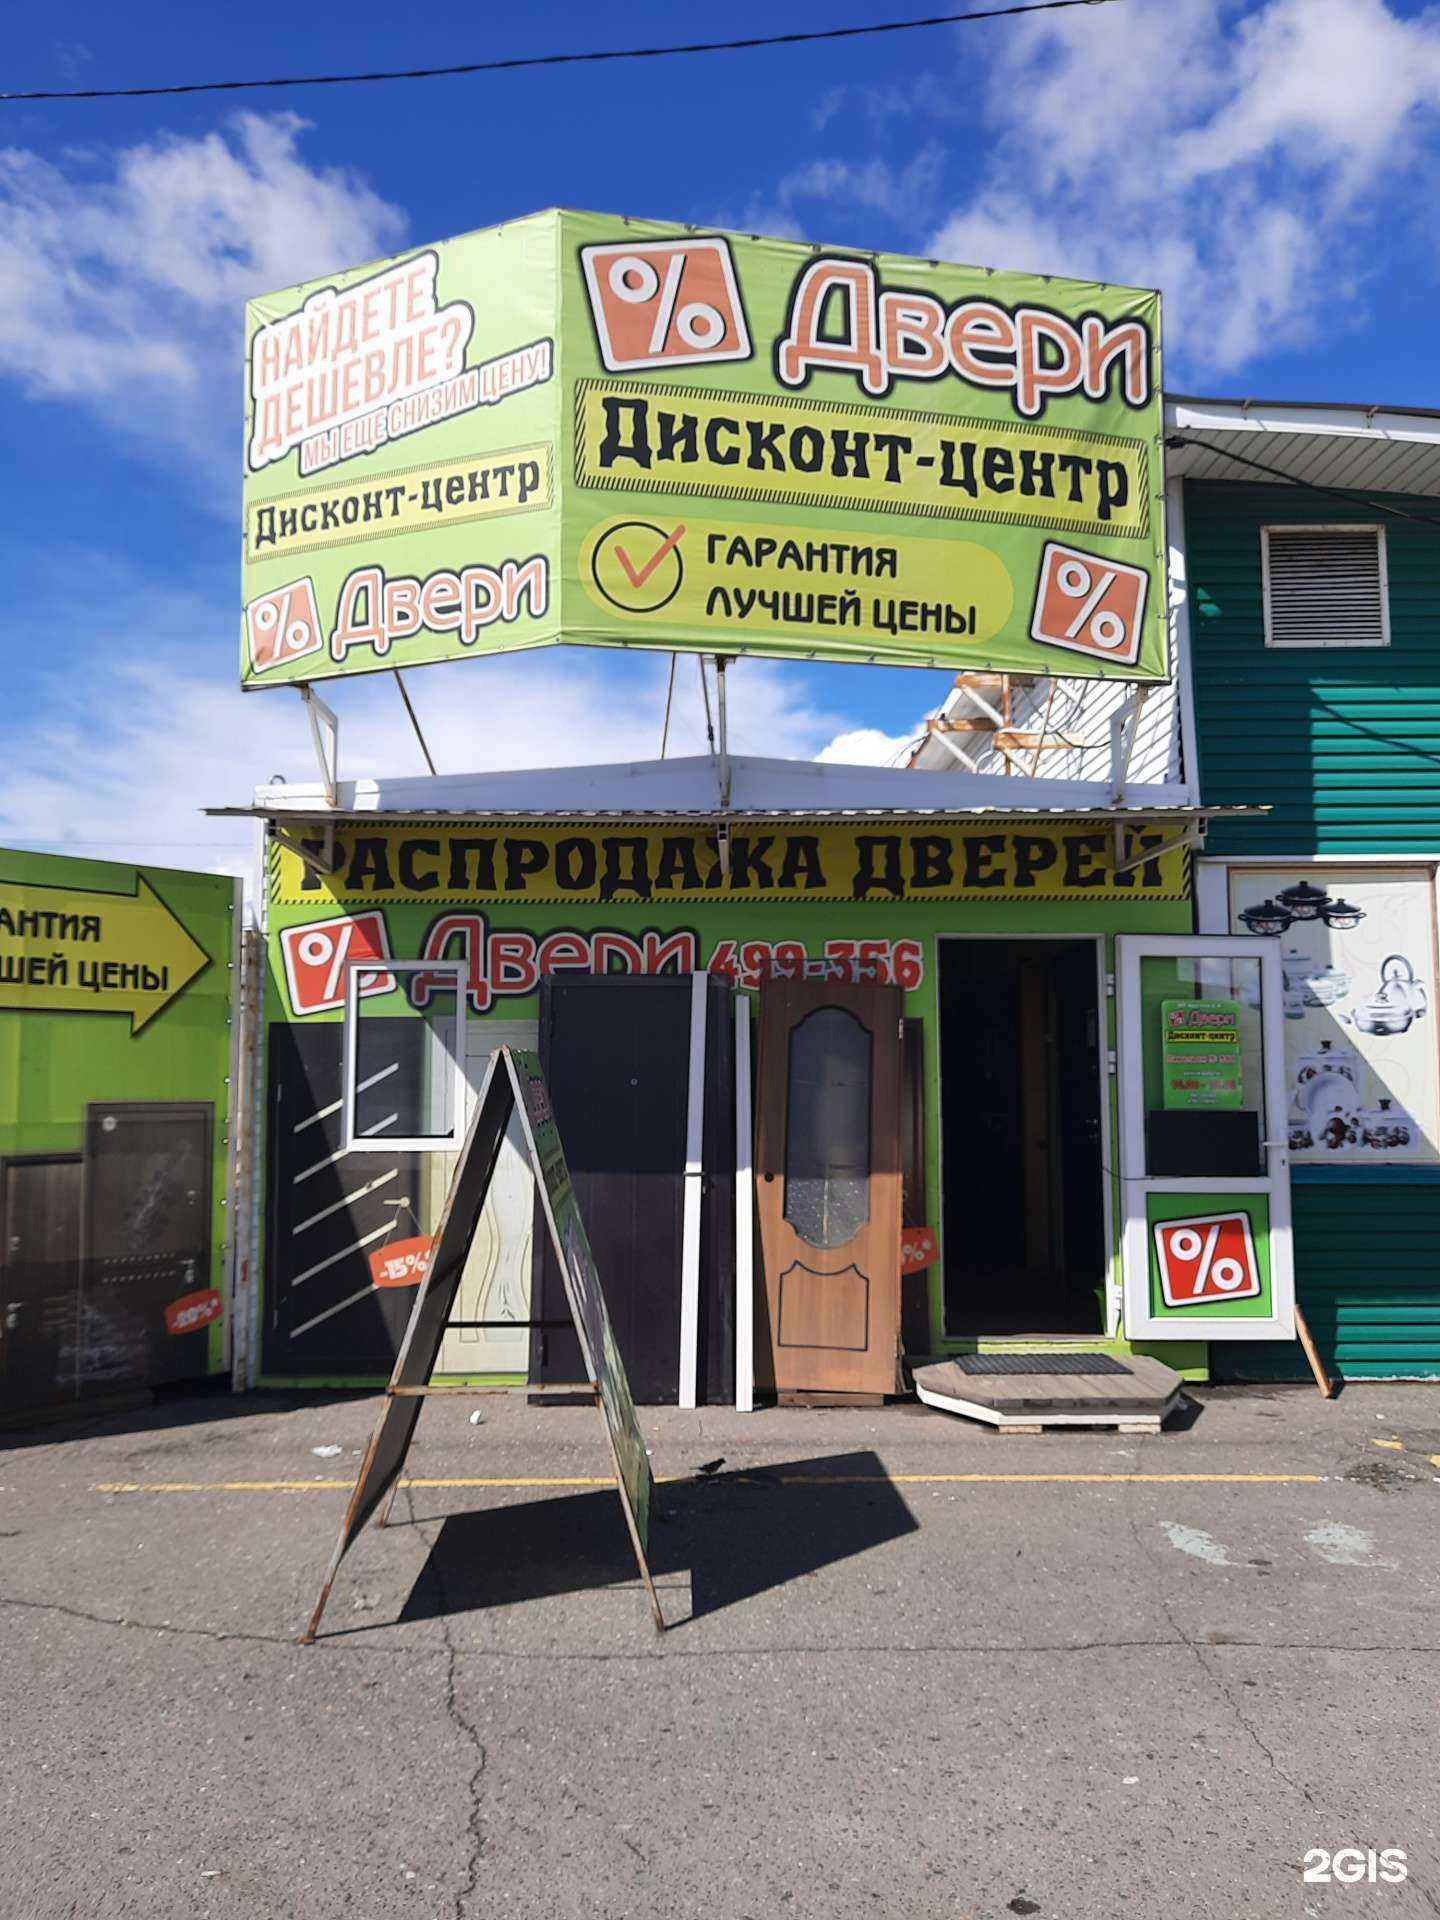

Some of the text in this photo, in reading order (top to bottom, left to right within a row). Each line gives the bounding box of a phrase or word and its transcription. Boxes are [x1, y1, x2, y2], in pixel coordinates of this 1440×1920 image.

[260, 266, 427, 388] НАЙДЕТЕ
[779, 255, 1151, 418] Двери
[258, 316, 461, 455] ДЕШЕВЛЕ?
[304, 345, 548, 470] МЫ ЕЩЕ СНИЗИМ ЦЕНУ!
[254, 460, 541, 549] Дисконт-центр
[598, 396, 1129, 521] Дисконт-центр
[331, 556, 548, 662] Двери
[705, 534, 899, 579] ГАРАНТИЯ
[705, 586, 976, 636] ЛУЧШЕЙ ЦЕНЫ
[299, 824, 1164, 898] РАСПРОДАЖА ДВЕРЕЙ
[78, 960, 169, 992] ЦЕНЫ
